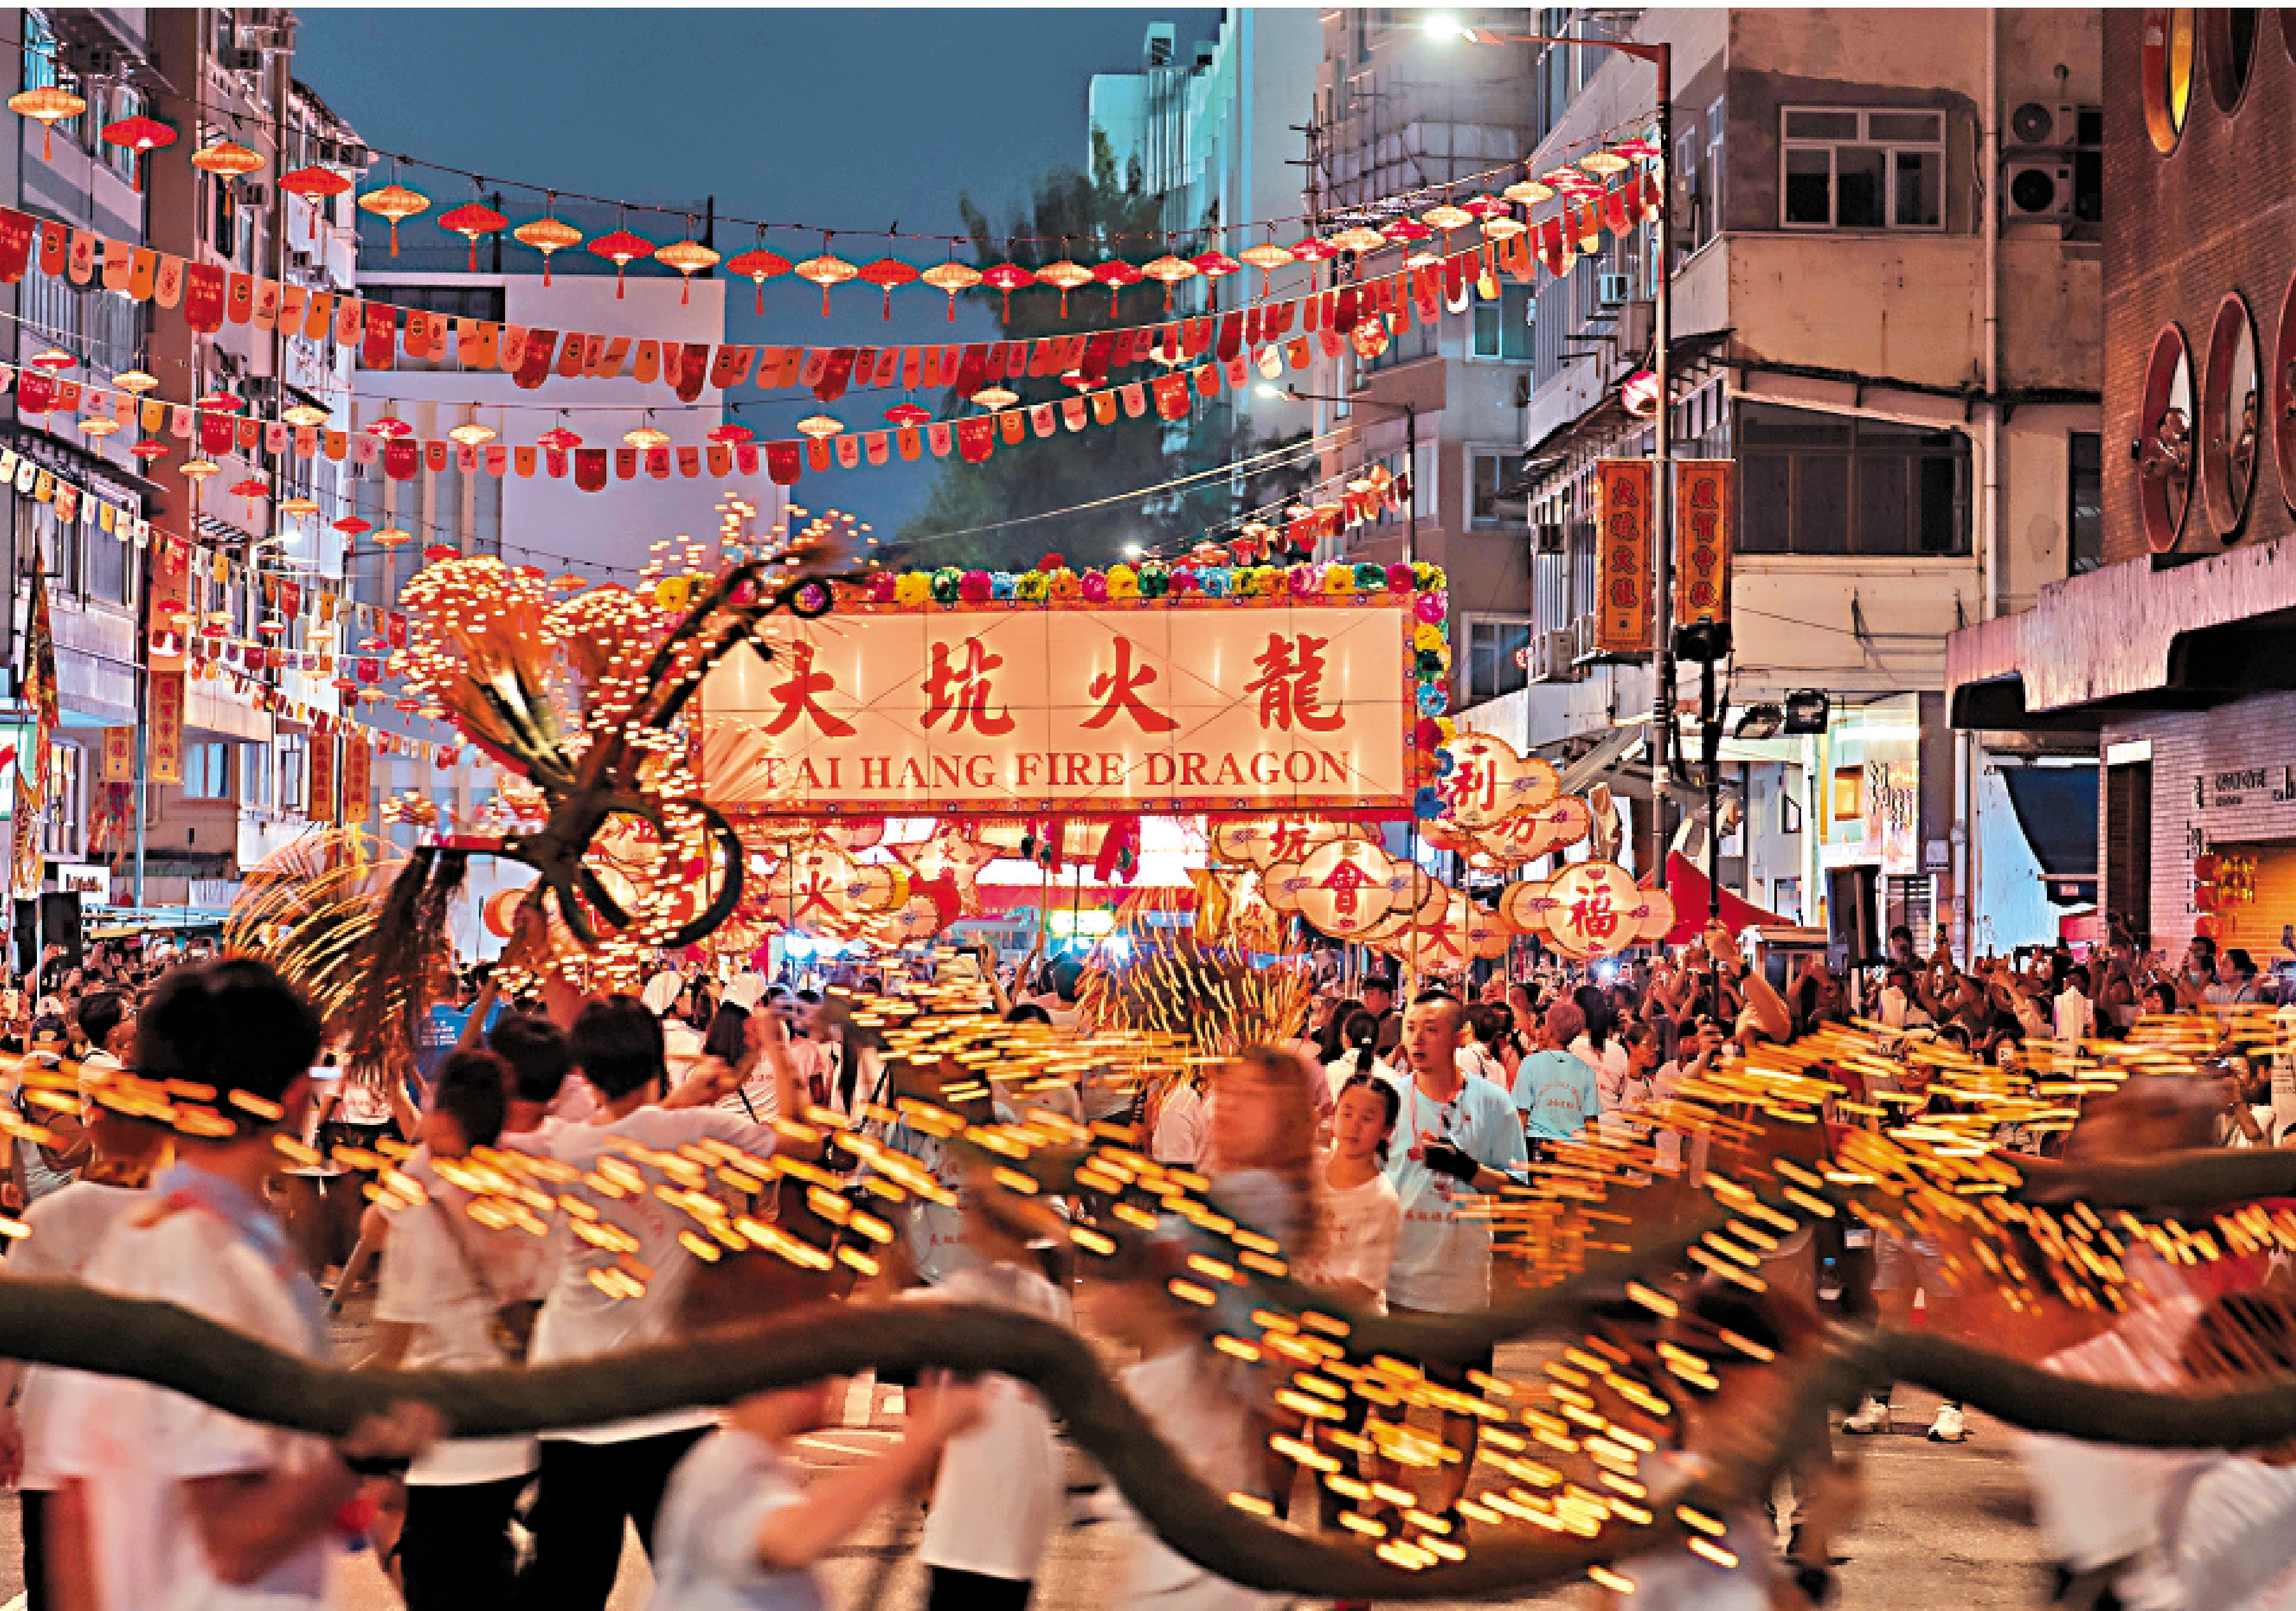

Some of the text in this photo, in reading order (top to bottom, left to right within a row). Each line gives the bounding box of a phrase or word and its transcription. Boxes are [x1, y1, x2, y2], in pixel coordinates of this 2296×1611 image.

[760, 632, 1346, 737] 大坑火龍
[756, 750, 1350, 789] TAI HANG FIRE DRAGON
[1450, 760, 1496, 812] 利
[795, 871, 841, 917] 火
[1318, 858, 1380, 916] 會
[1566, 883, 1618, 939] 福
